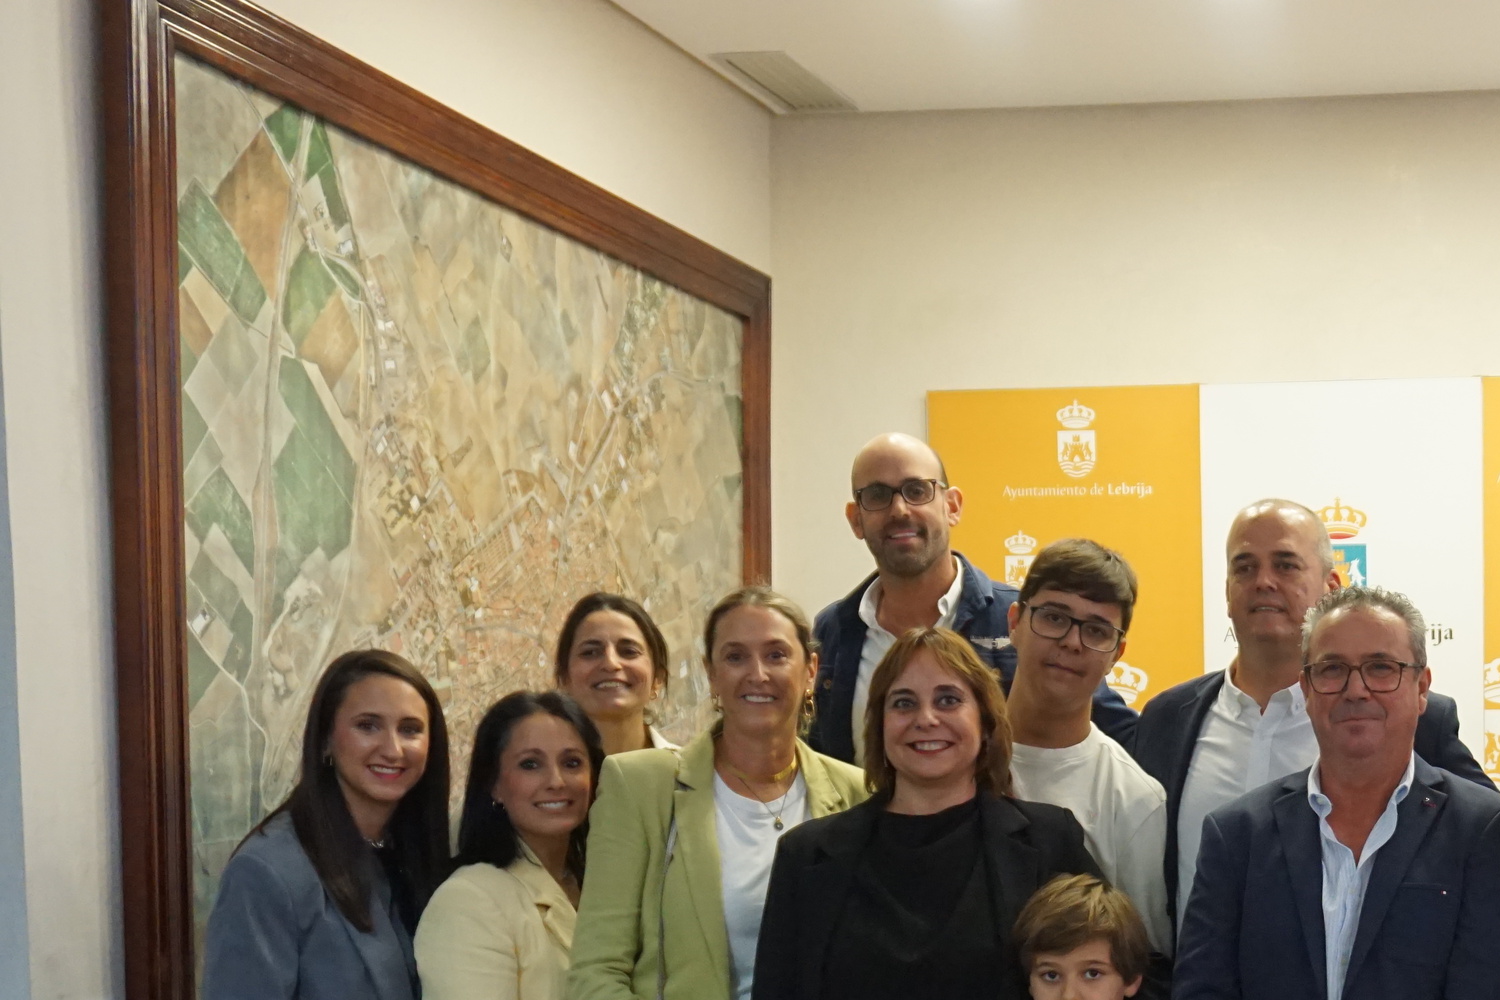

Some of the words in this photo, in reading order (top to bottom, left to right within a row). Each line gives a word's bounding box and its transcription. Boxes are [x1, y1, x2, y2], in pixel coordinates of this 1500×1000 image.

[1003, 484, 1087, 499] Ayuntamiento
[1090, 483, 1104, 495] de
[1107, 482, 1153, 498] Lebrija
